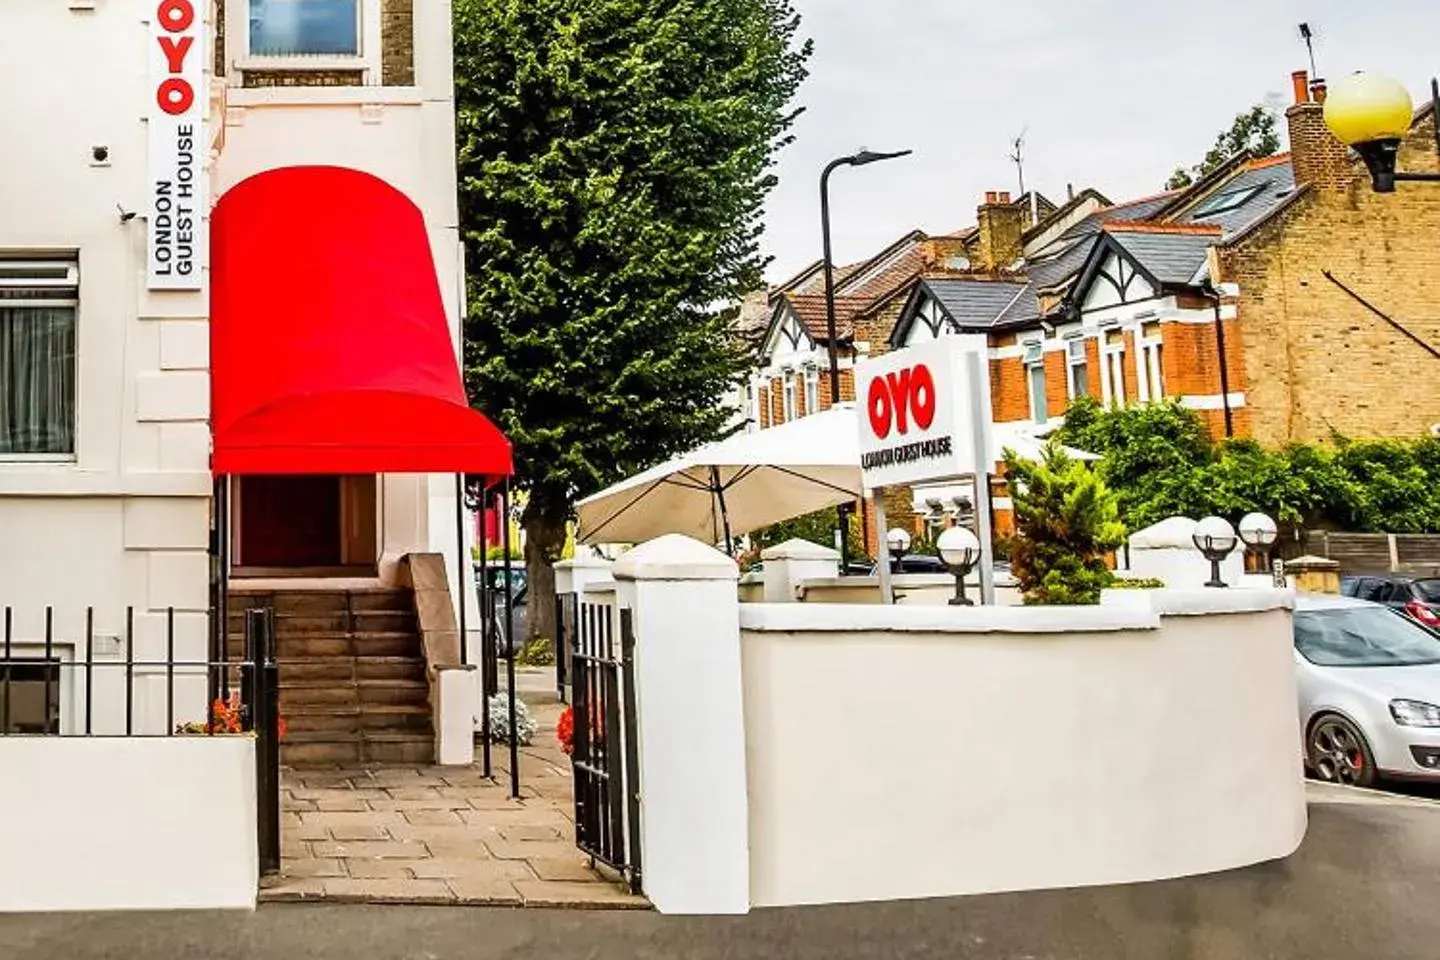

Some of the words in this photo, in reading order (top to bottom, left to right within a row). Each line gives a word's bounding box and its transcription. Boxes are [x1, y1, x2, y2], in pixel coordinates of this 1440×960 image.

[176, 124, 193, 198] HOUSE
[155, 181, 172, 275] LONDON
[176, 205, 193, 276] GUEST
[867, 364, 936, 439] OYO
[894, 442, 920, 463] GUEST
[921, 436, 952, 458] HOUSE
